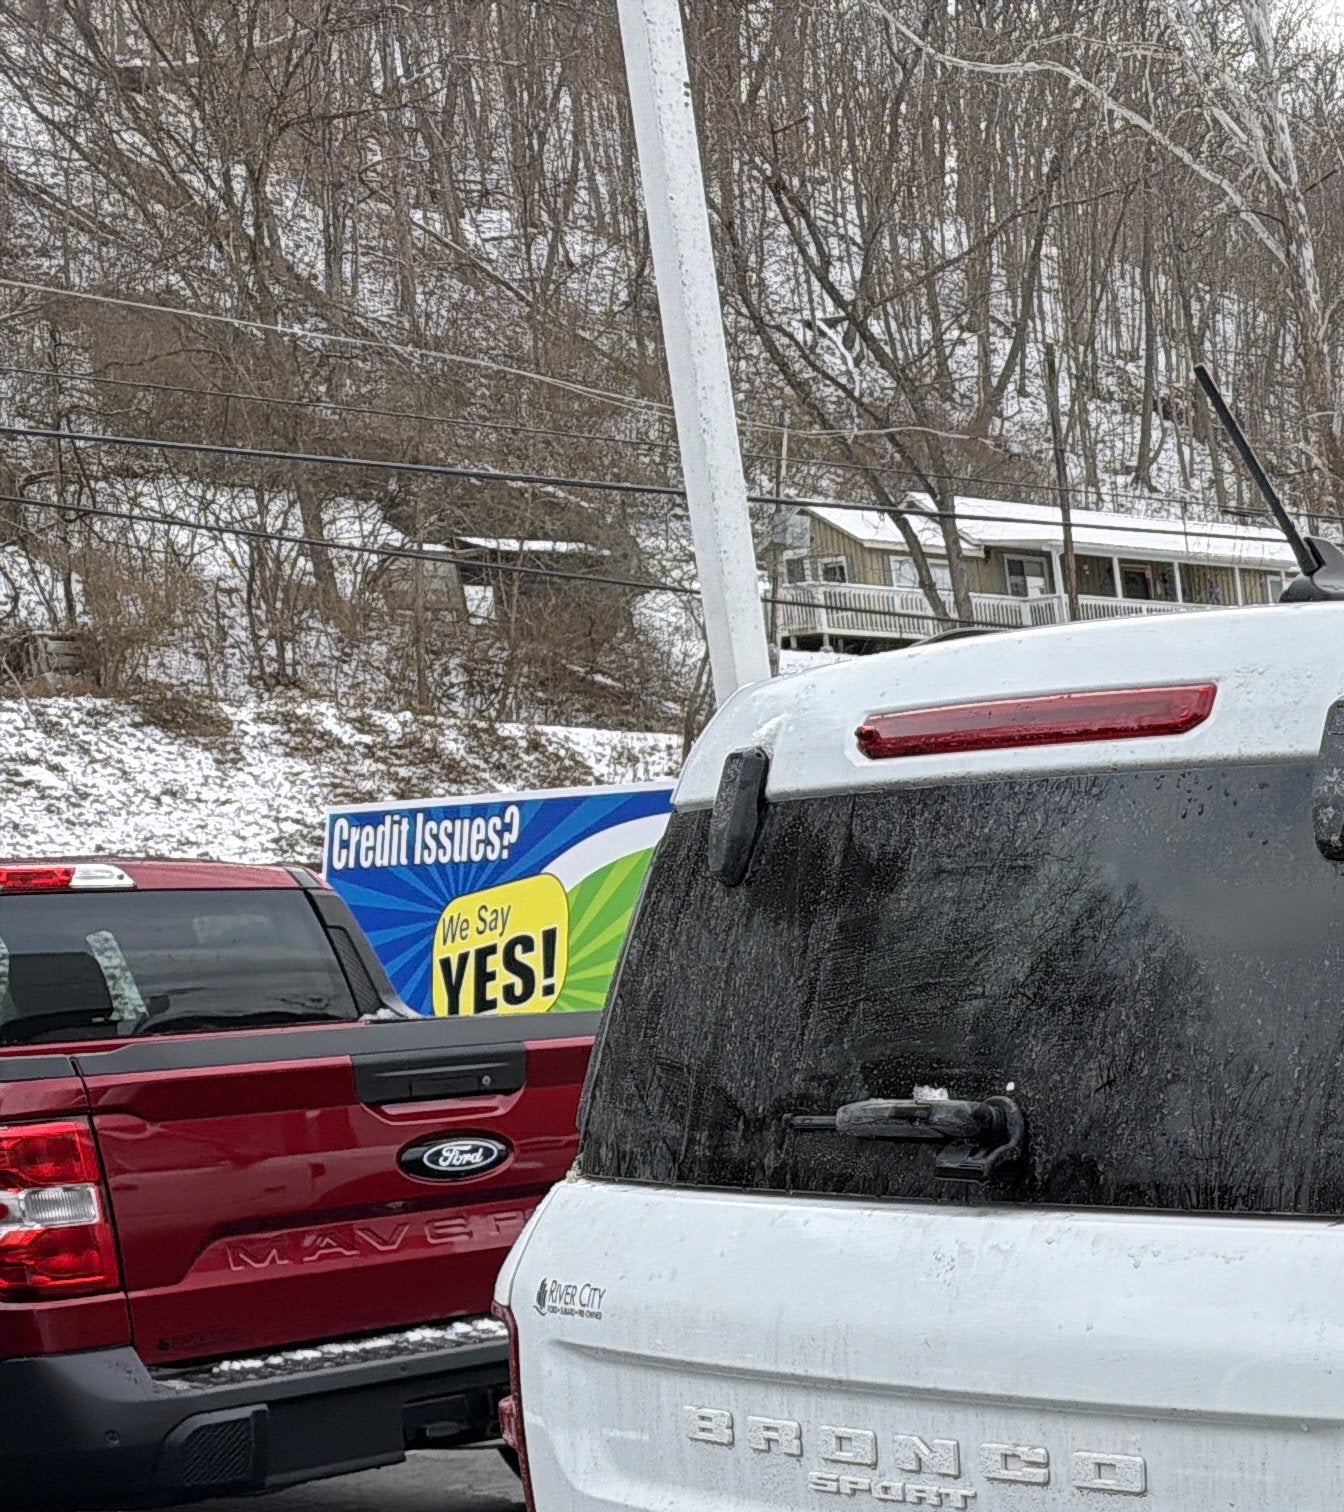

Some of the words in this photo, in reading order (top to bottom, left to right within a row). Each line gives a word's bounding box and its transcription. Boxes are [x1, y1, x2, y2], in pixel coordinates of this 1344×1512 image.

[331, 813, 410, 870] Credit
[413, 804, 520, 865] Issues?
[441, 911, 470, 947] We
[475, 903, 512, 938] Say
[438, 926, 558, 1016] YES!
[438, 1144, 485, 1167] Ford
[548, 1279, 578, 1306] RIVER
[578, 1282, 607, 1309] CITY
[684, 1404, 1148, 1496] BRONCO
[807, 1469, 978, 1510] SPORT
